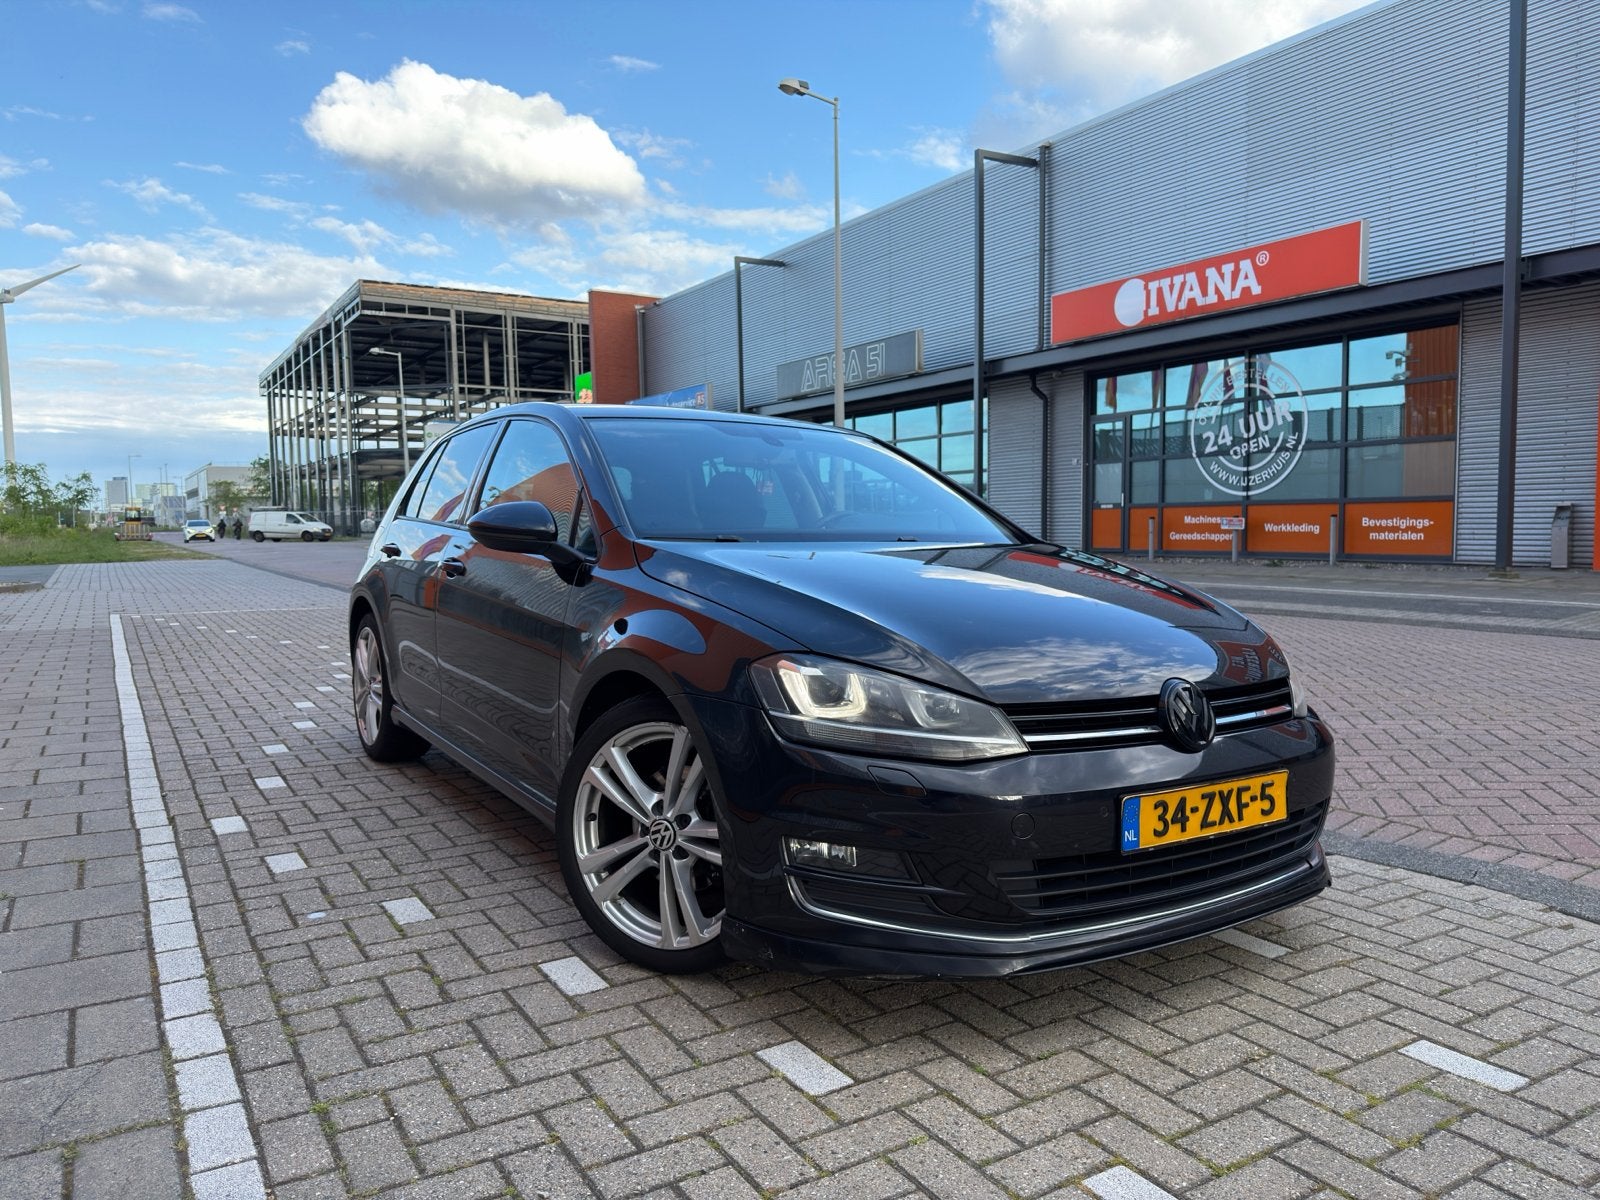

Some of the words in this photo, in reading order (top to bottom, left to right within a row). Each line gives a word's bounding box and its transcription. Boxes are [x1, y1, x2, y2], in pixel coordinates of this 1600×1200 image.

[1202, 424, 1233, 455] 24
[1239, 401, 1294, 439] UUR
[1230, 434, 1270, 460] OPEN
[1184, 515, 1221, 524] Machines
[1361, 517, 1434, 529] Bevestigings-
[1264, 523, 1320, 534] Werkkleding
[1369, 531, 1424, 541] materialen
[1153, 780, 1276, 837] 34-ZXF-5
[1124, 829, 1138, 842] NL
